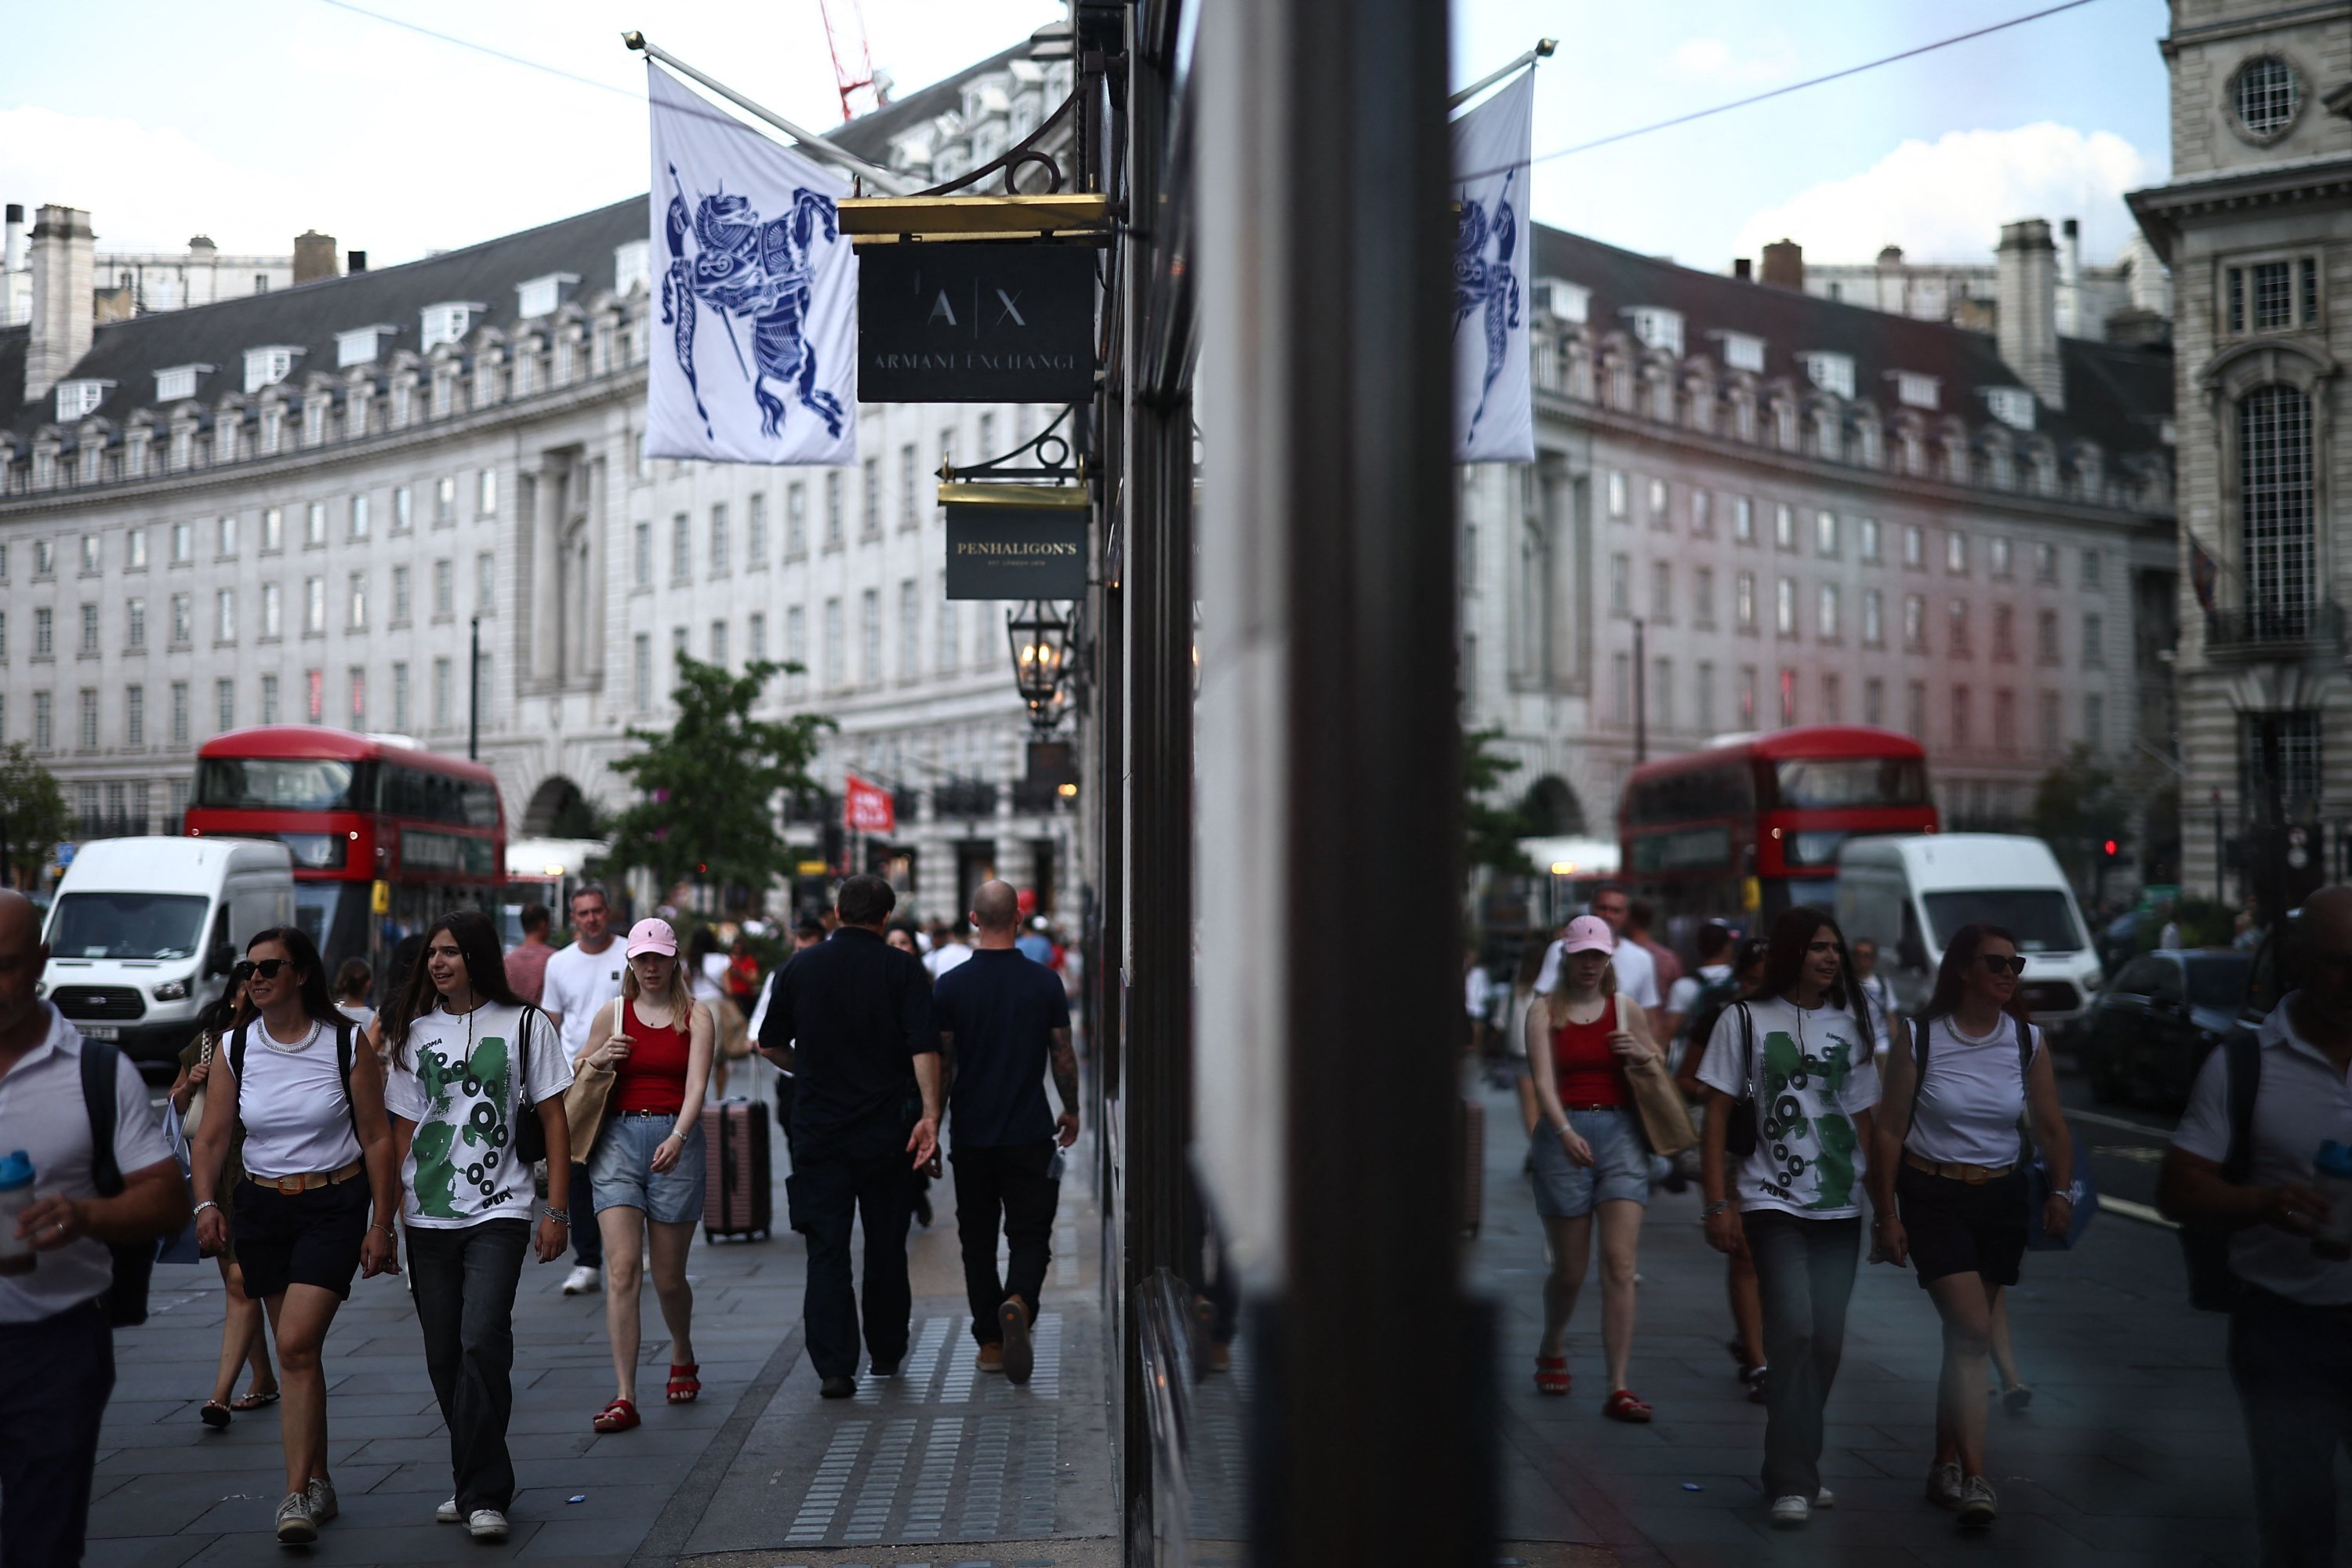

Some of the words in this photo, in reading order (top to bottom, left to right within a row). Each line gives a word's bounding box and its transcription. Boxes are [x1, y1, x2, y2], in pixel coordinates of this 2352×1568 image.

[927, 289, 957, 326] A
[996, 289, 1026, 326] X
[875, 354, 954, 369] ARMANI
[967, 354, 1073, 369] EXCHANGE
[957, 543, 1077, 555] PENHALIGON'S
